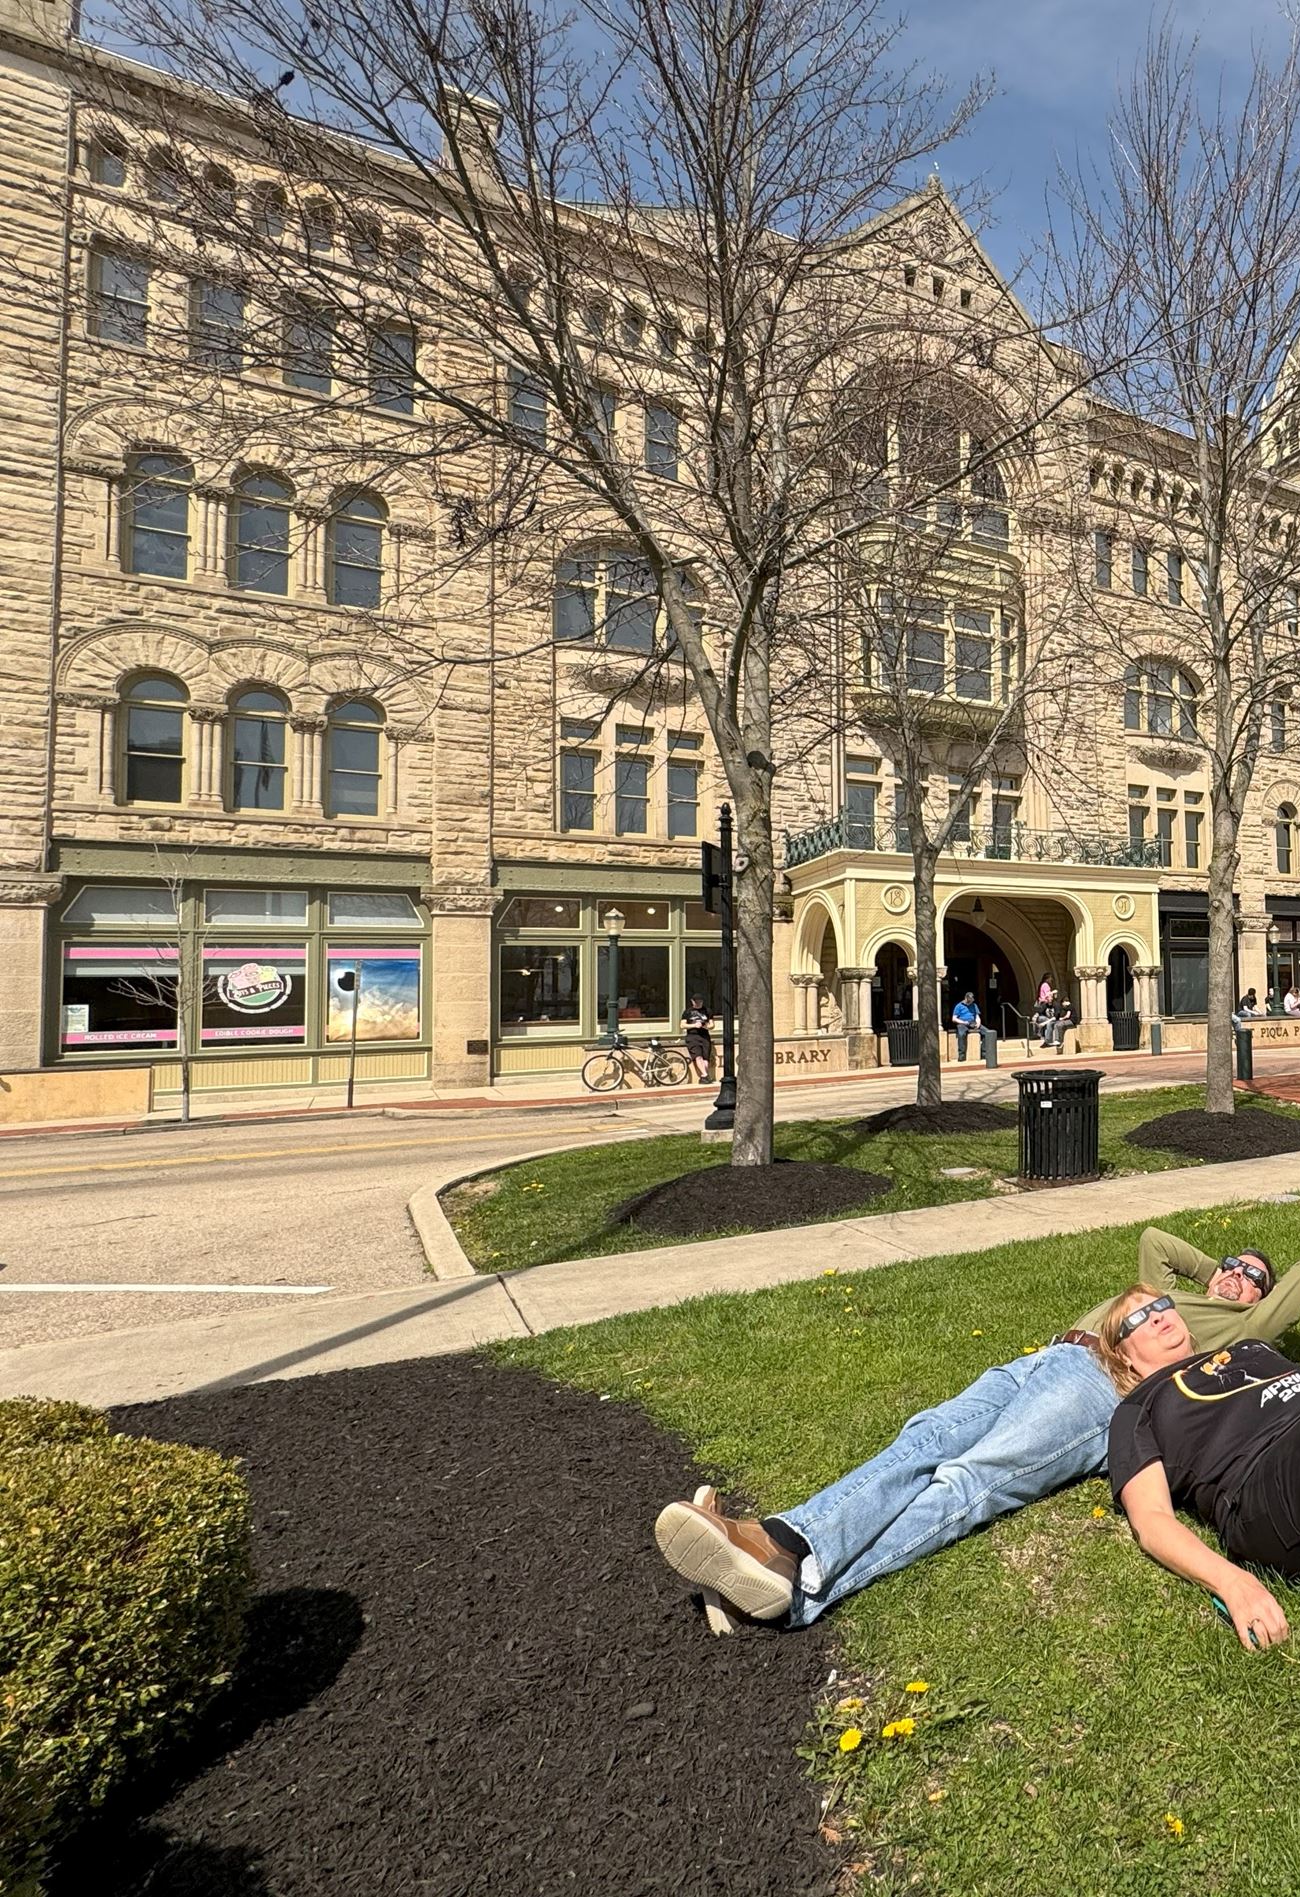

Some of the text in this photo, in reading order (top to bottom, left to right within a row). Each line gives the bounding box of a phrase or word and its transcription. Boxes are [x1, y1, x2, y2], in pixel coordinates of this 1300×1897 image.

[84, 1033, 115, 1041] ROLLED
[131, 1032, 158, 1040] CREAM
[1260, 1026, 1289, 1039] PIQUA
[775, 1049, 832, 1065] BRARY
